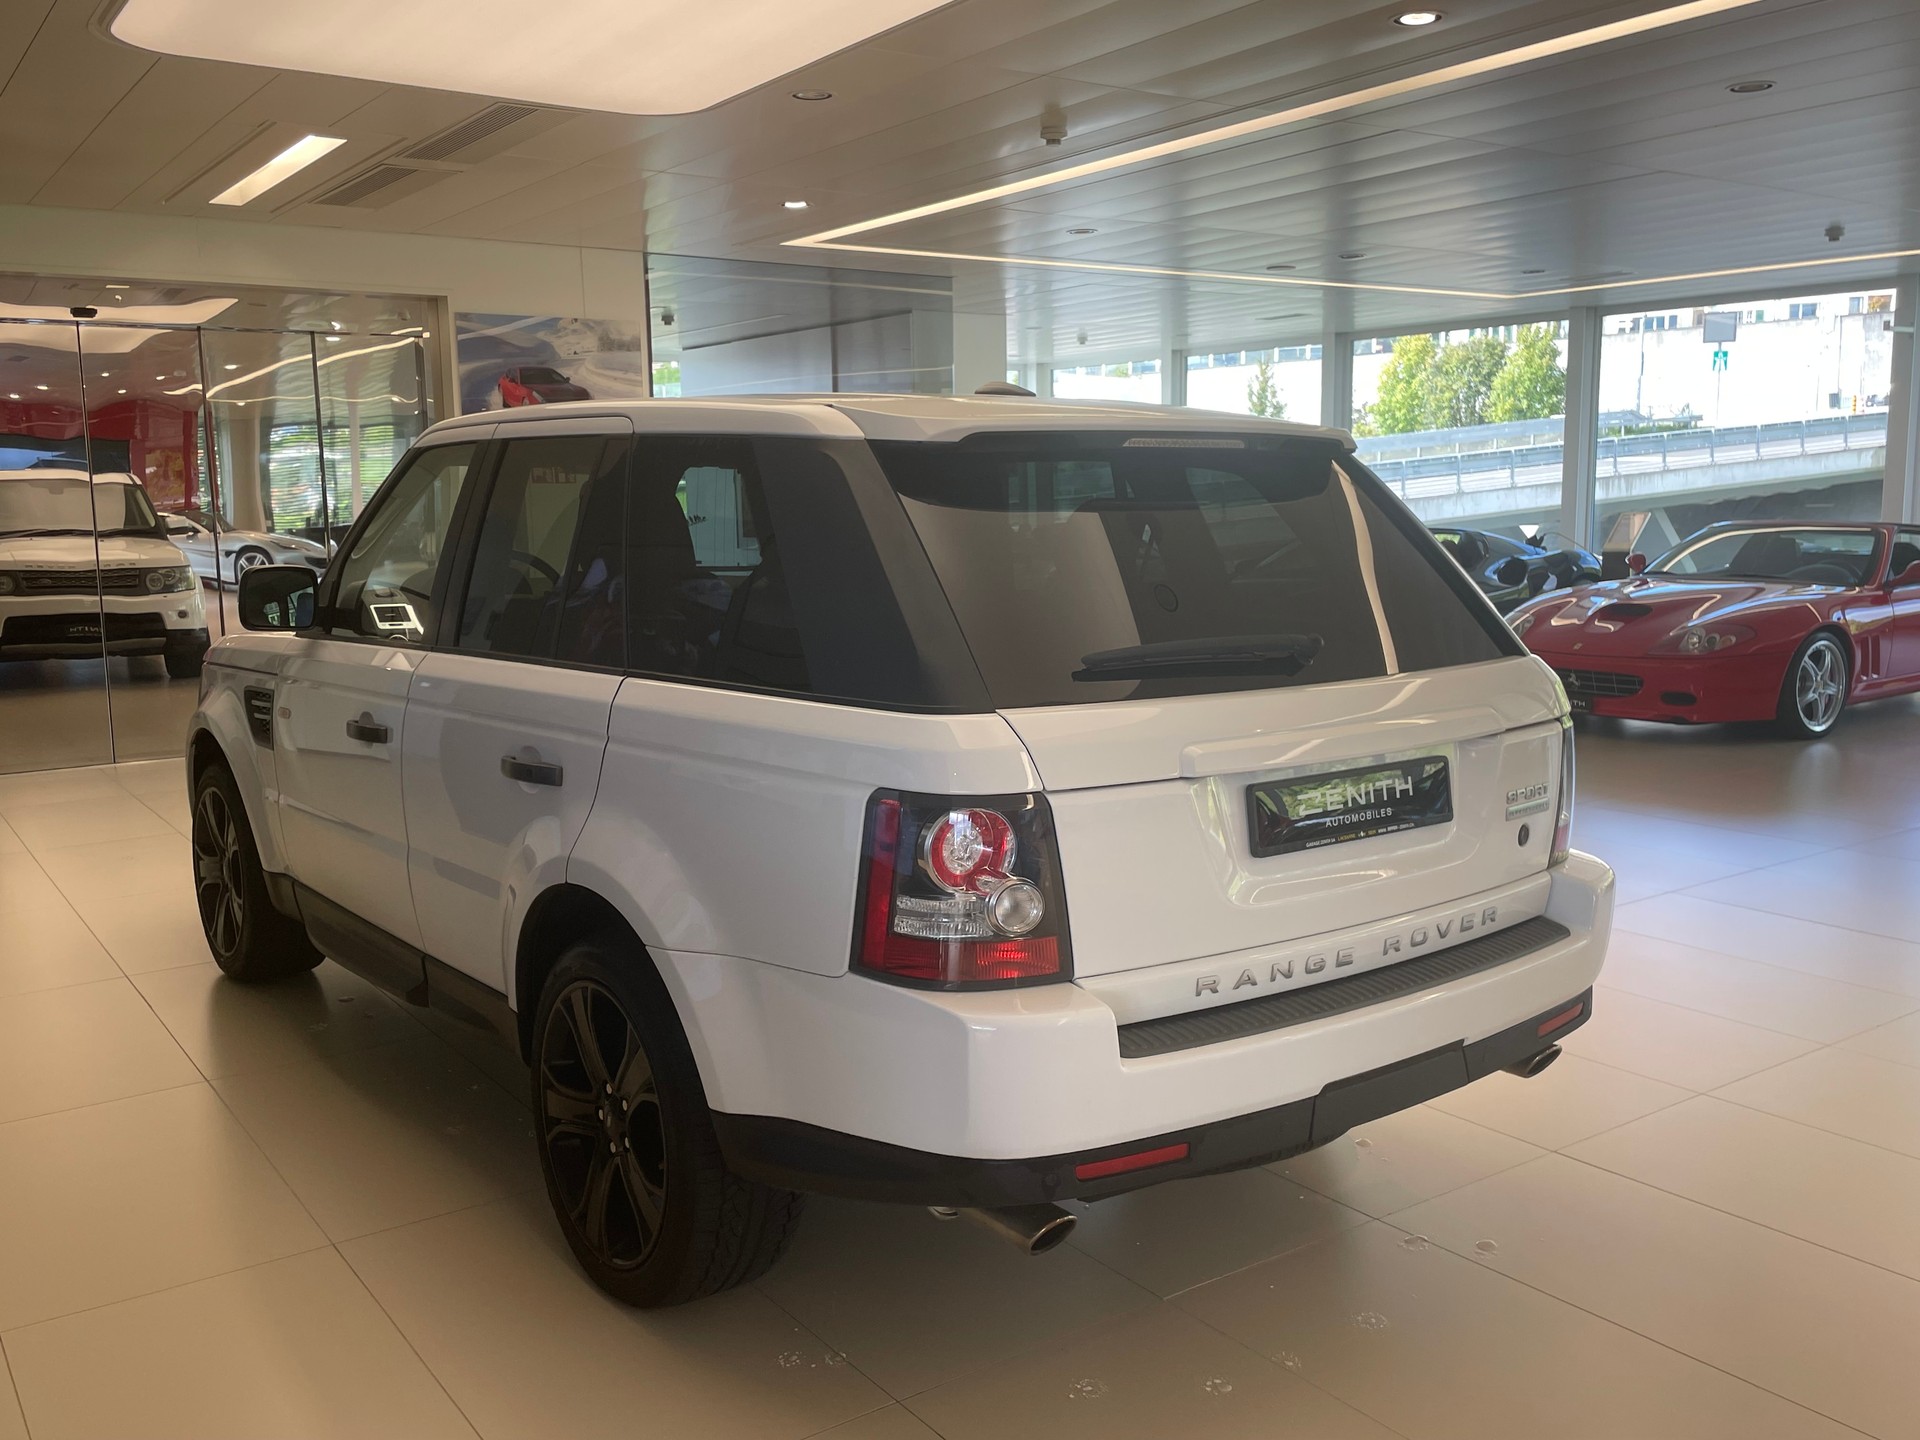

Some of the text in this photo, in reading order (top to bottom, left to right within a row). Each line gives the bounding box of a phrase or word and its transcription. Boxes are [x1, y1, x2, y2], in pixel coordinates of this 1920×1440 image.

[1297, 776, 1414, 816] ZENITH
[1325, 807, 1393, 828] AUTOMOBILES
[1195, 906, 1498, 997] RANGE ROVER
